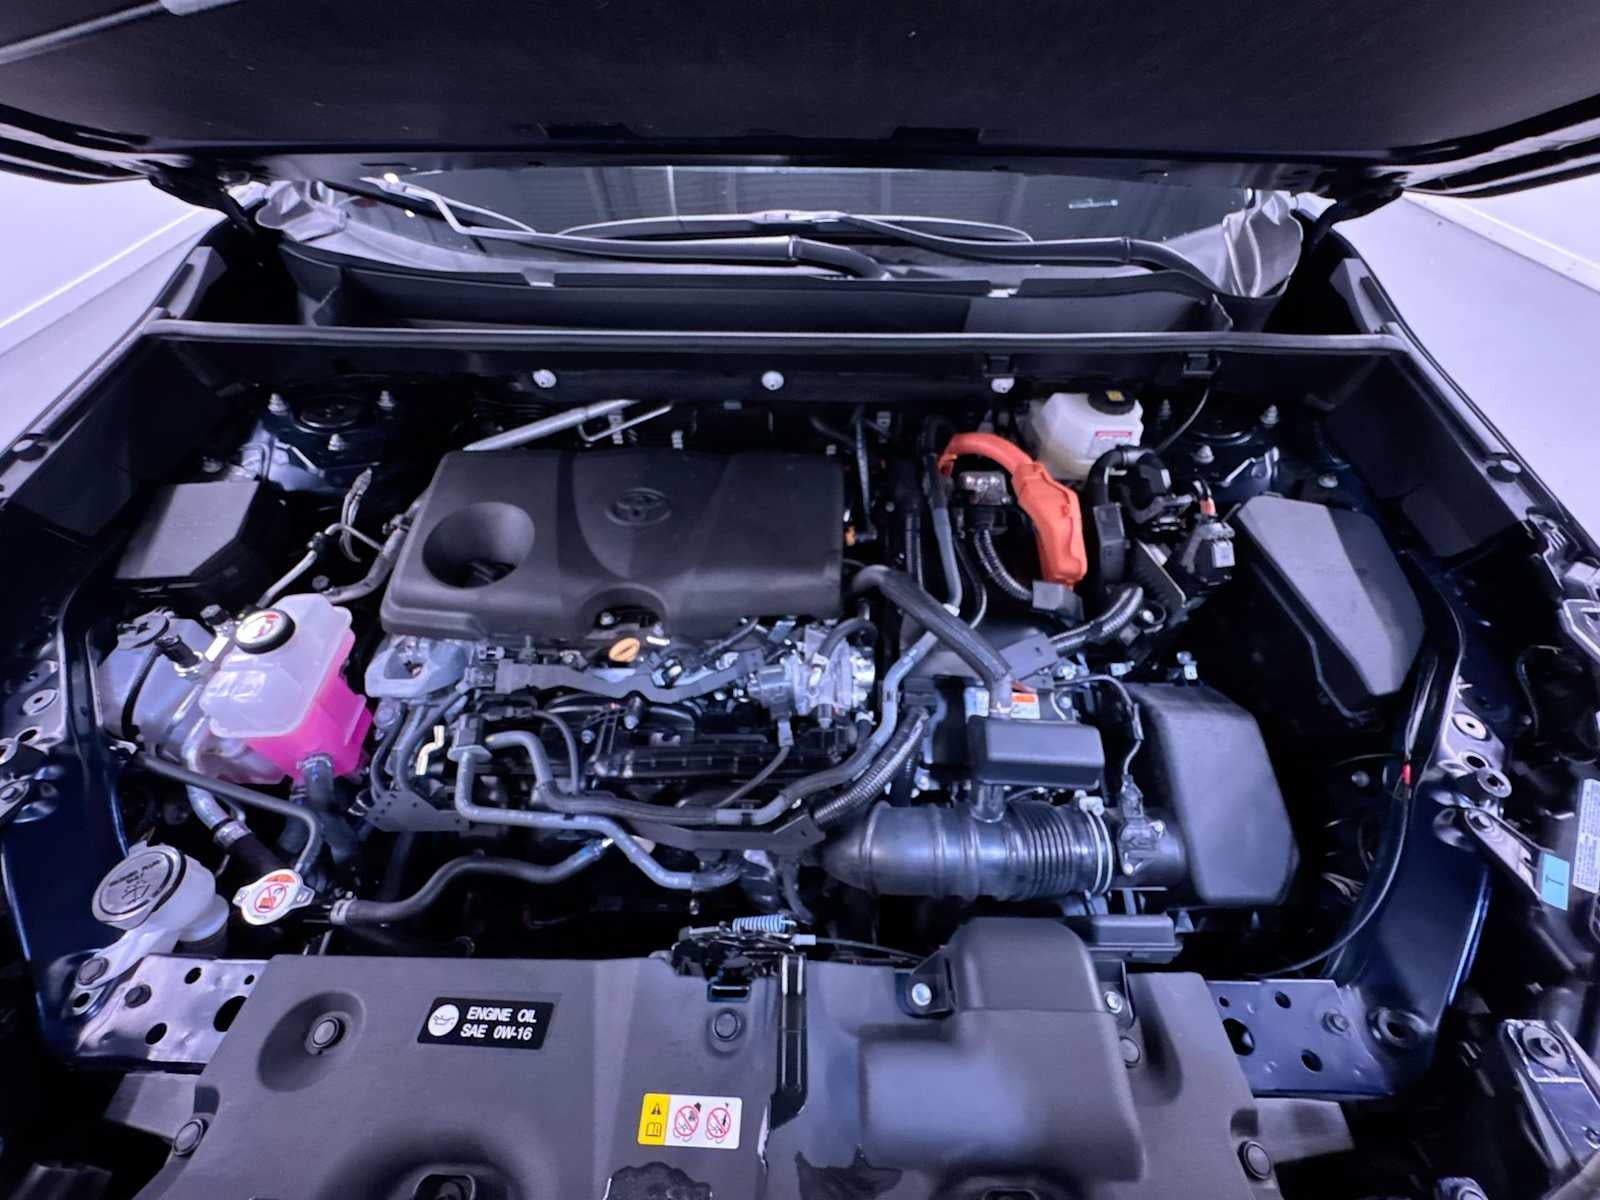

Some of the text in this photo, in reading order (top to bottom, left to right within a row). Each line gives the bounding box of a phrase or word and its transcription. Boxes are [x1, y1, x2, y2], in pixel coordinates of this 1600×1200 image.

[466, 1006, 537, 1023] ENGINE OIL
[460, 1023, 533, 1041] SAE 0W-16
